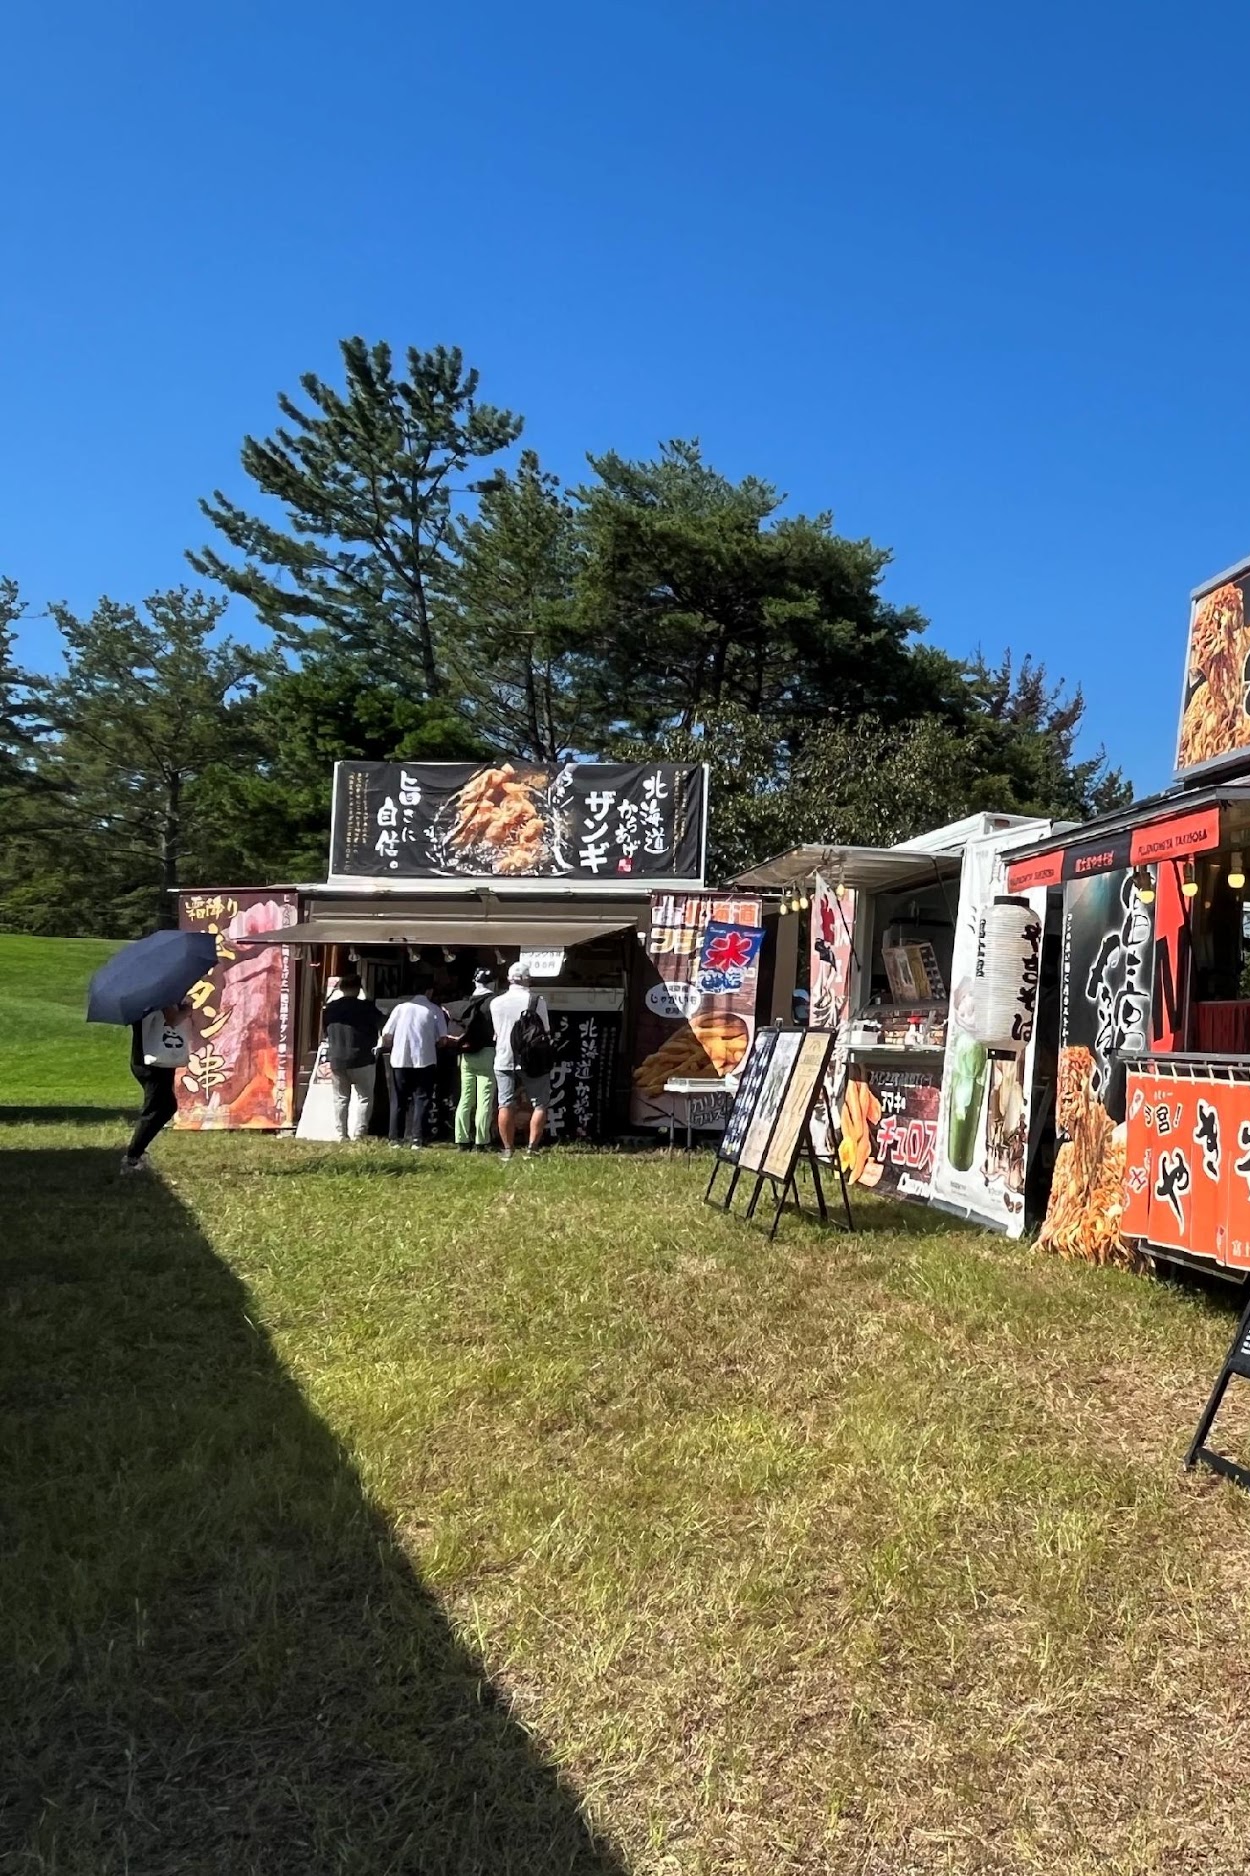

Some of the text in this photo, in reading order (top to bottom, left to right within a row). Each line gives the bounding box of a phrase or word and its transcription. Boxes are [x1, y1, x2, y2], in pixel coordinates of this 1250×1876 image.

[376, 796, 400, 869] 自信。
[399, 770, 422, 842] 旨さに
[579, 791, 616, 873] ザンギ
[615, 799, 640, 858] からあげ
[640, 770, 669, 854] 北海道
[185, 897, 238, 919] 霜降り
[702, 932, 752, 972] 氷
[877, 1114, 938, 1172] チュロス
